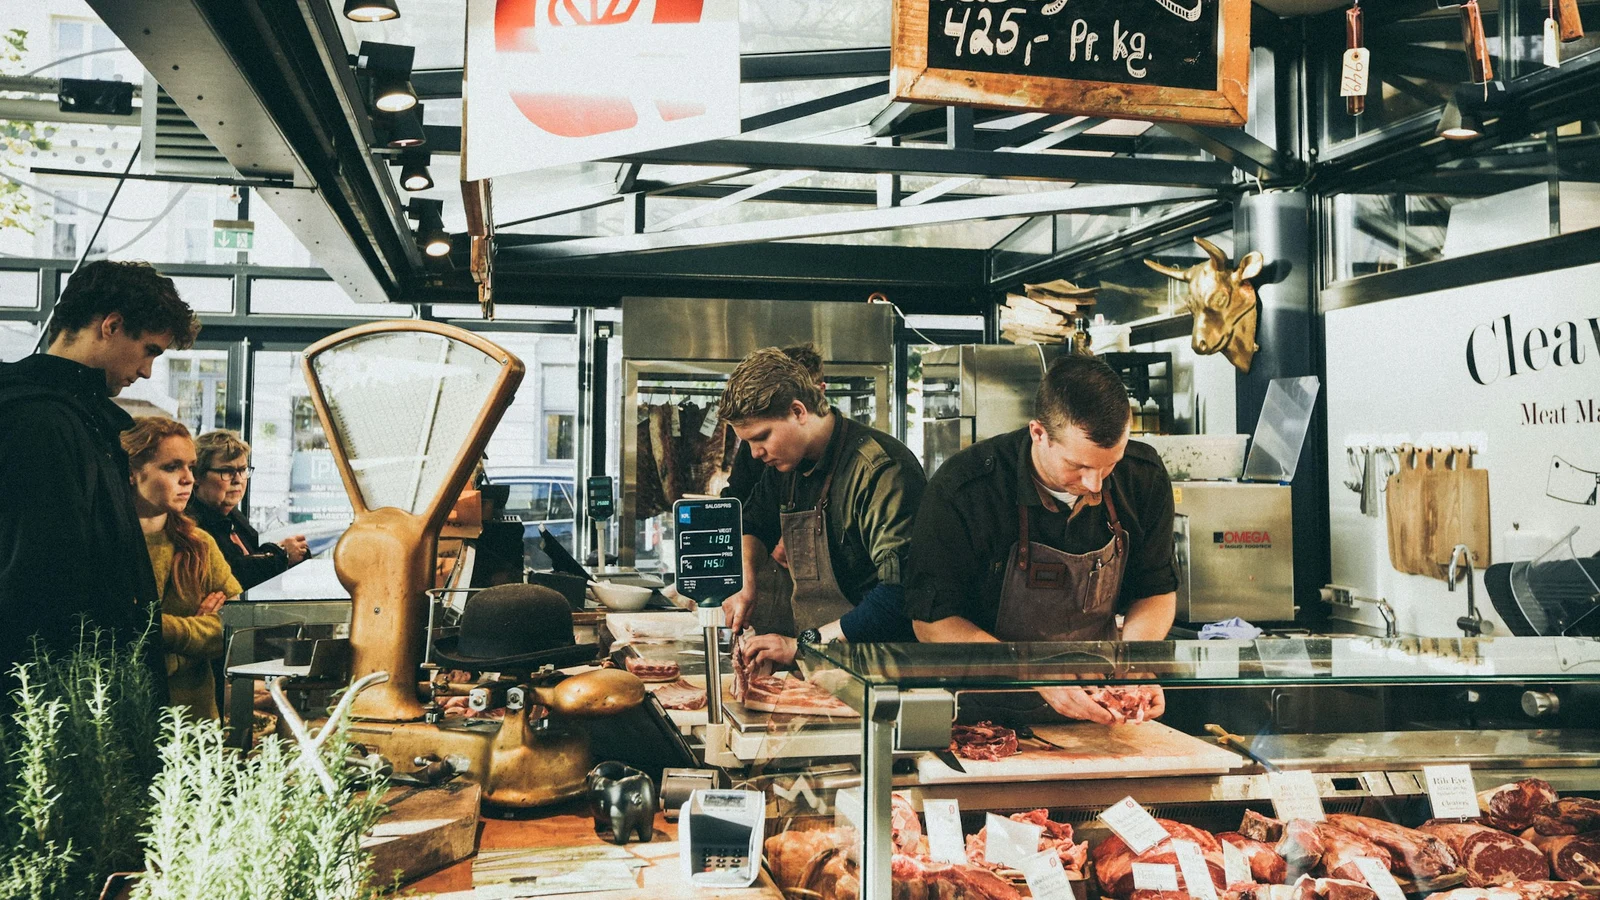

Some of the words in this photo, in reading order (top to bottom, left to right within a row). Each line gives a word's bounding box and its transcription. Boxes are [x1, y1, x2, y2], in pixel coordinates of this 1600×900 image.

[944, 7, 1049, 66] 425,-
[1069, 18, 1099, 62] Pr.
[1113, 19, 1152, 78] kg.
[1521, 402, 1567, 425] Meat
[1224, 531, 1271, 544] OMEGA
